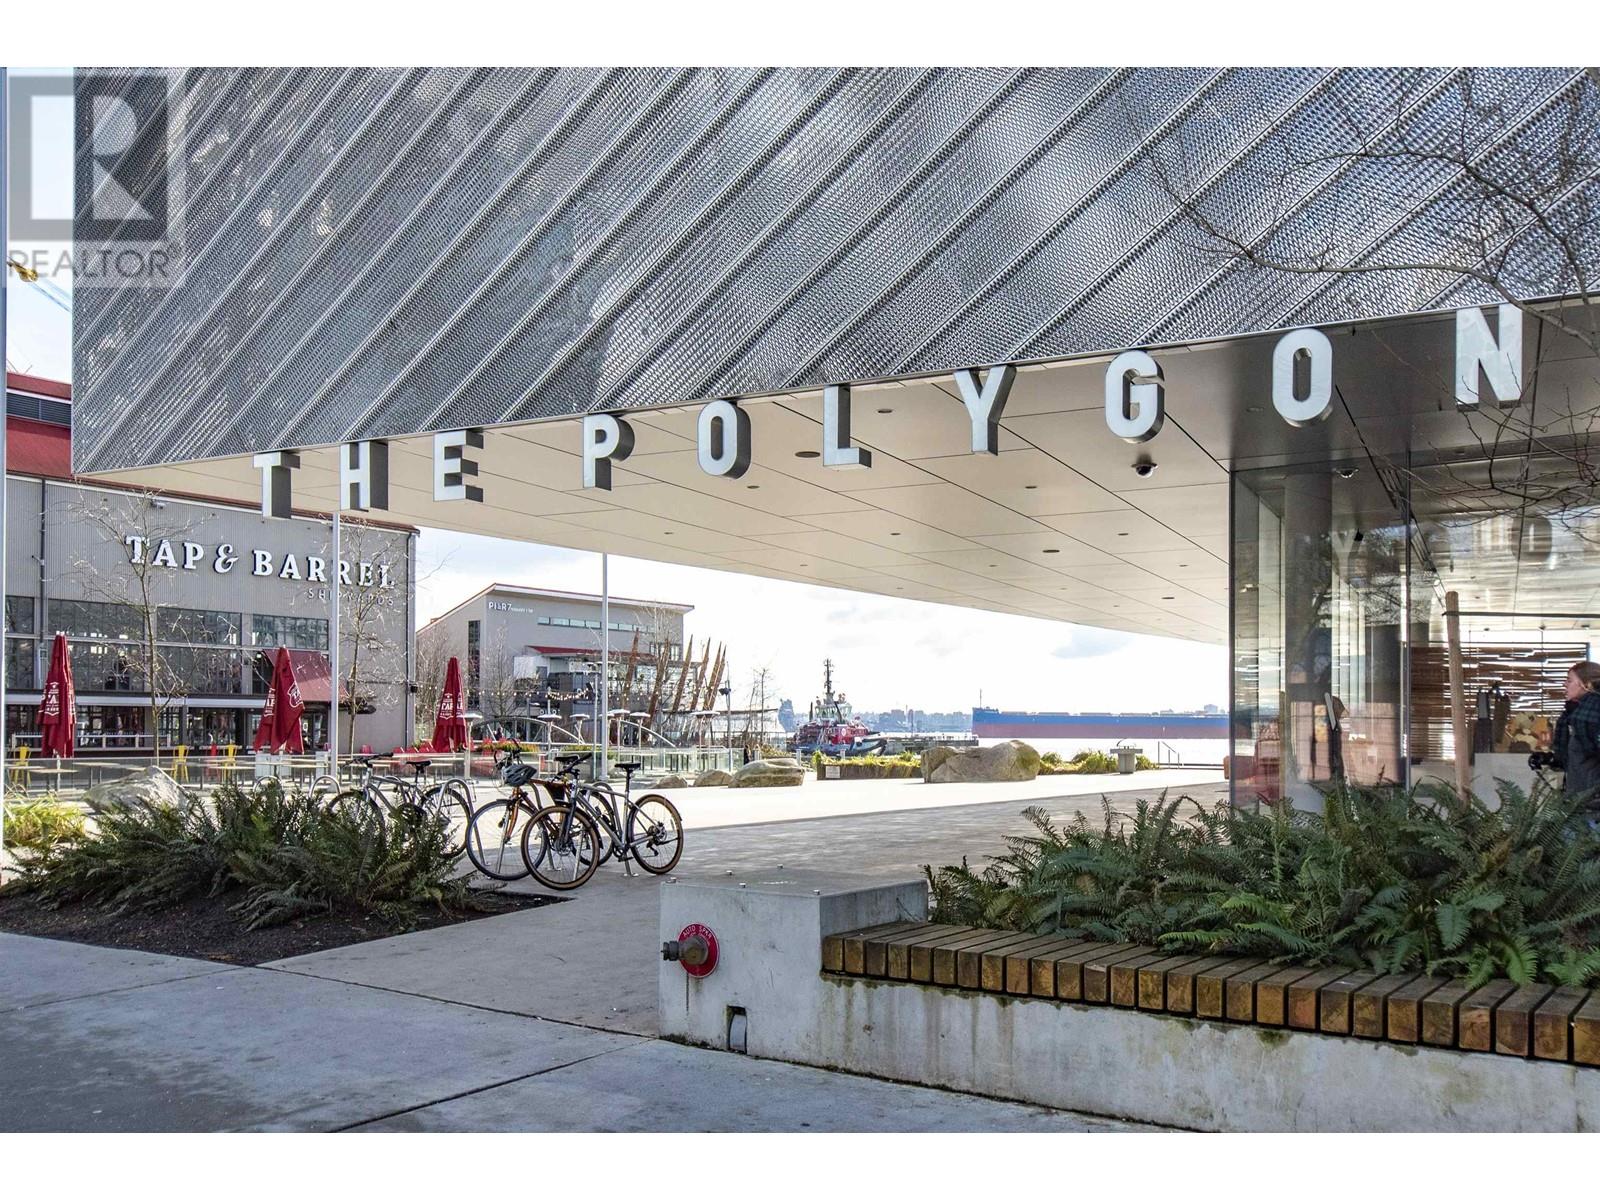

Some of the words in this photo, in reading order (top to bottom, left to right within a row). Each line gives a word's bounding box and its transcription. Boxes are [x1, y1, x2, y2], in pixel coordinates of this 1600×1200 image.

[253, 430, 484, 518] THE
[582, 302, 1523, 492] POLYGON
[125, 535, 204, 570] TAP
[213, 543, 239, 574] &
[252, 549, 395, 589] BARREL
[682, 925, 696, 938] AUTO
